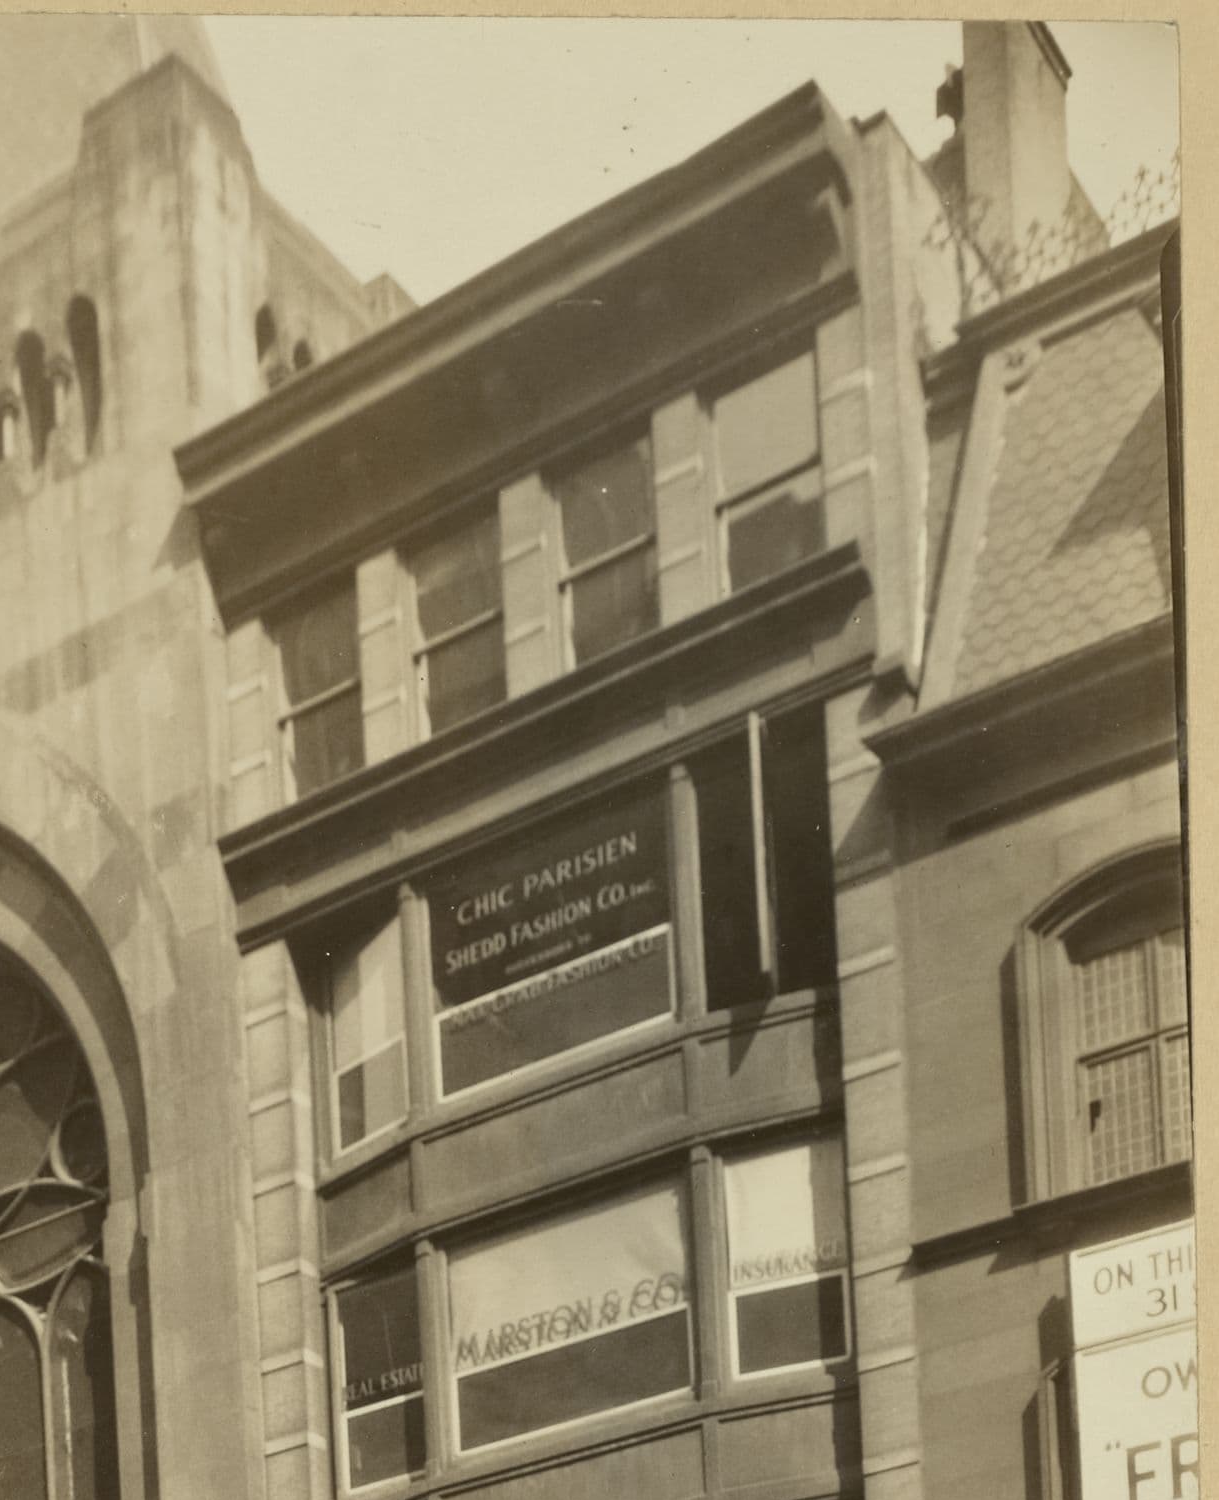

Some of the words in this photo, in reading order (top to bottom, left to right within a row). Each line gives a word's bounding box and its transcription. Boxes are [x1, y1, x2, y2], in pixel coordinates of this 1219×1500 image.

[457, 884, 514, 926] CHIC
[523, 831, 638, 898] PARISIEN
[446, 932, 507, 975] SHEDD
[510, 896, 592, 947] FASHION
[1093, 1259, 1134, 1296] ON
[1146, 1285, 1178, 1318] 31
[454, 1297, 593, 1373] MARSTON
[599, 1288, 624, 1327] &
[342, 1378, 376, 1402] EAL
